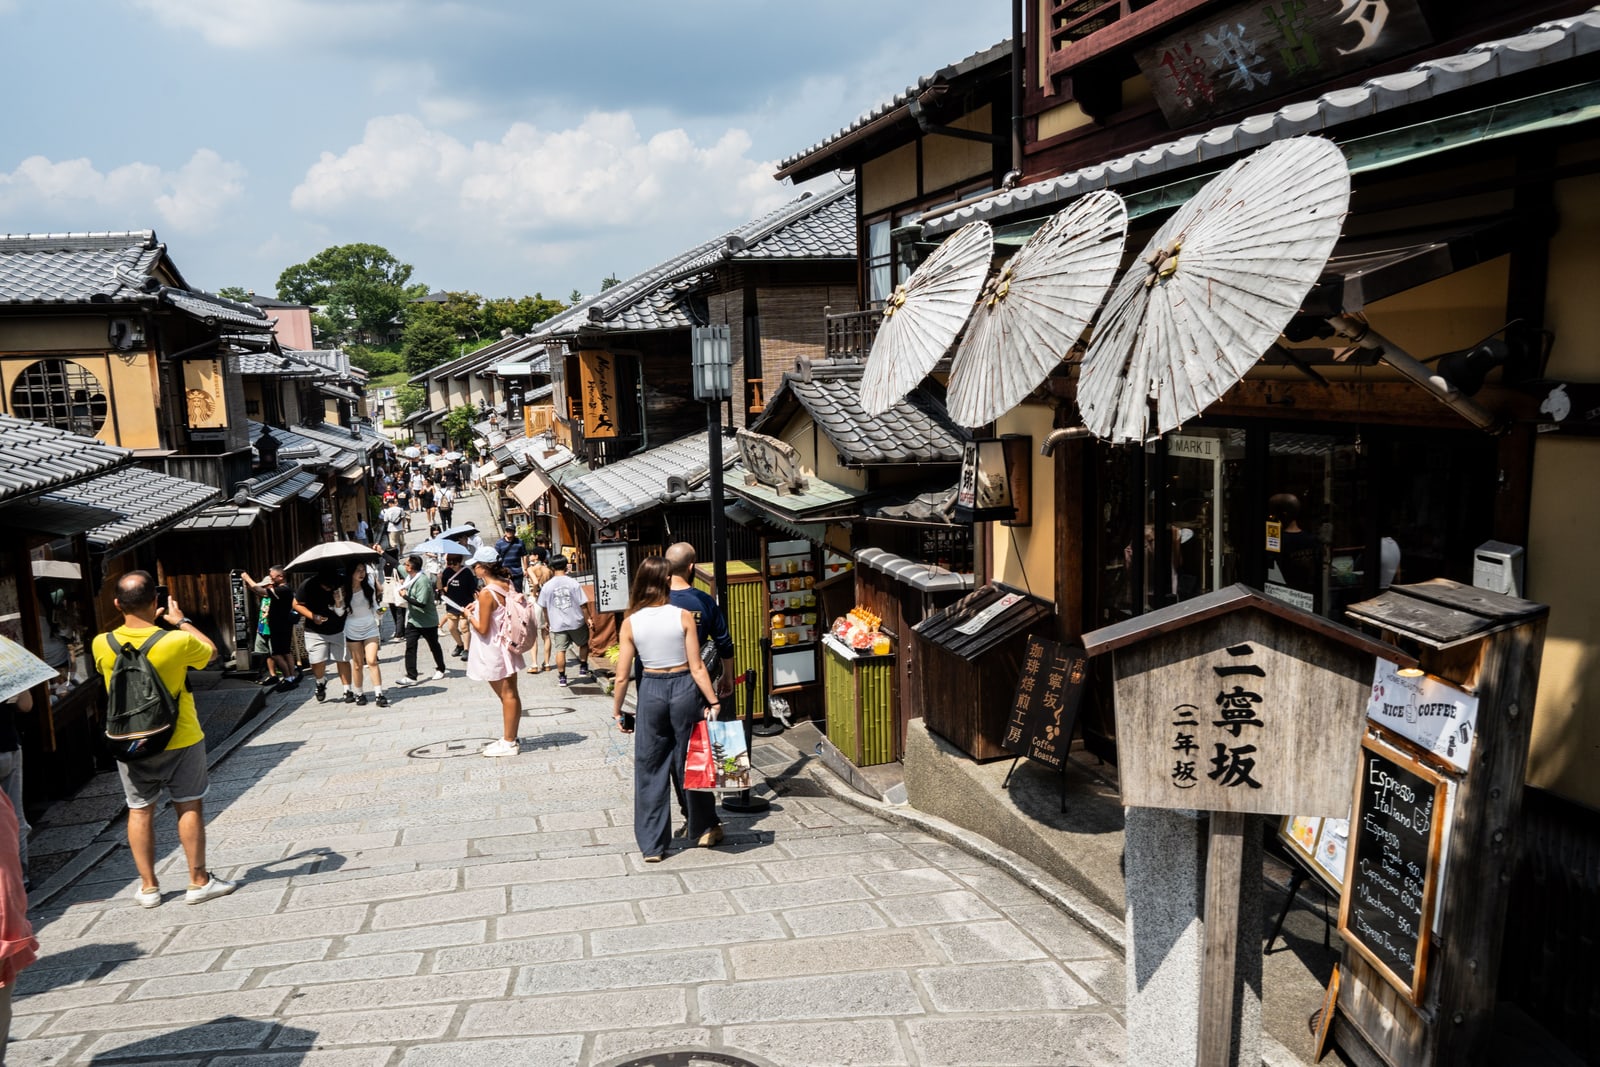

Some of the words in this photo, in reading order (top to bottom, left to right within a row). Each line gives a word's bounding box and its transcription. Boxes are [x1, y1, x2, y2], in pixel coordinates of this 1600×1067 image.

[1176, 440, 1202, 454] MARK
[963, 446, 976, 491] 珈琲
[600, 579, 611, 606] ふたば
[1042, 657, 1068, 709] 二寧坂
[1070, 658, 1085, 685] 京都
[1007, 642, 1044, 744] 珈琲焙煎工房
[1382, 702, 1405, 718] NICE
[1418, 703, 1457, 719] COFFEE
[1207, 643, 1266, 790] 二寧坂
[1032, 736, 1056, 752] Coffee
[1033, 747, 1060, 766] Roaster
[1370, 759, 1415, 803] Espresso
[1373, 791, 1411, 828] Italiano
[1366, 813, 1400, 849] Espresso
[1360, 883, 1395, 919] Macchiato
[1357, 909, 1383, 944] Espresso
